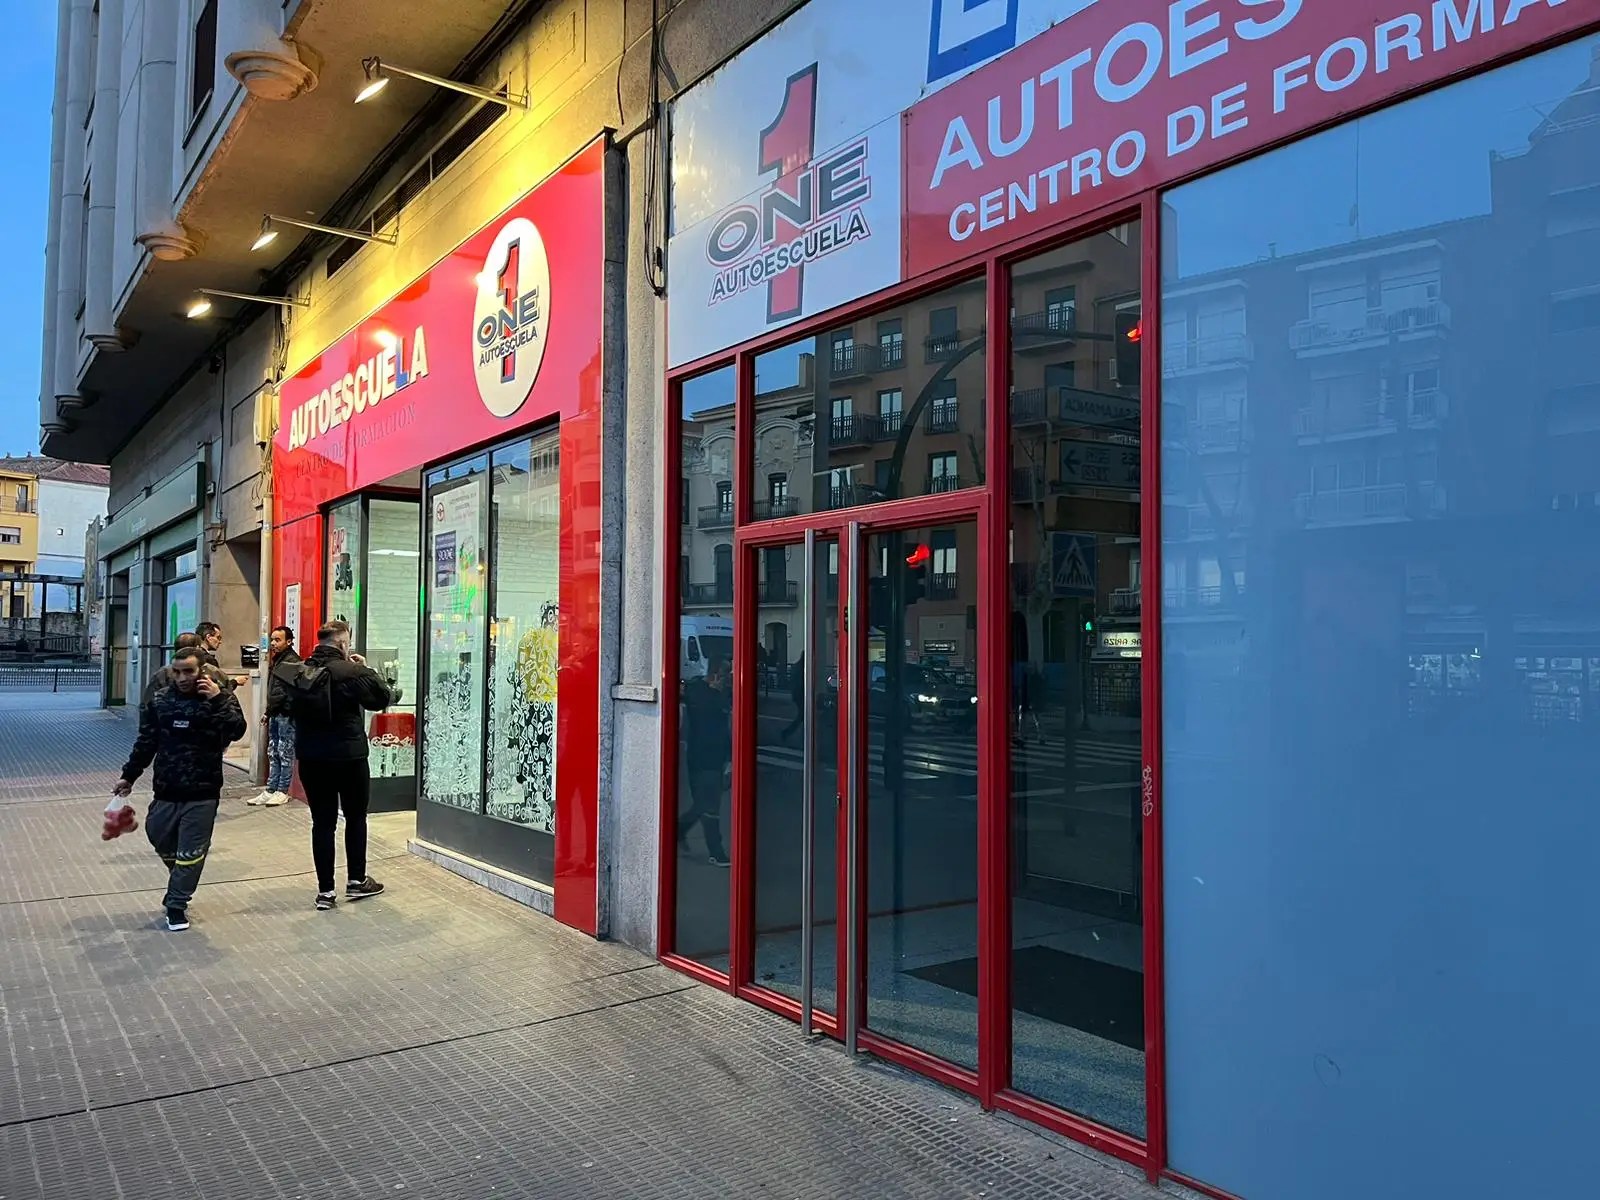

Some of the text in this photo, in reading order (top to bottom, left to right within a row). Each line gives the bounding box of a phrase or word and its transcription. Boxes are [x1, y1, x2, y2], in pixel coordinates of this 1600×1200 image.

[706, 137, 871, 266] ONE
[948, 130, 1147, 241] CENTRO
[1167, 83, 1248, 157] DE
[709, 208, 870, 305] AUTOESCUELA
[477, 286, 539, 347] ONE
[479, 327, 537, 366] AUTOESCUELA
[288, 325, 429, 452] AUTOESCUELA
